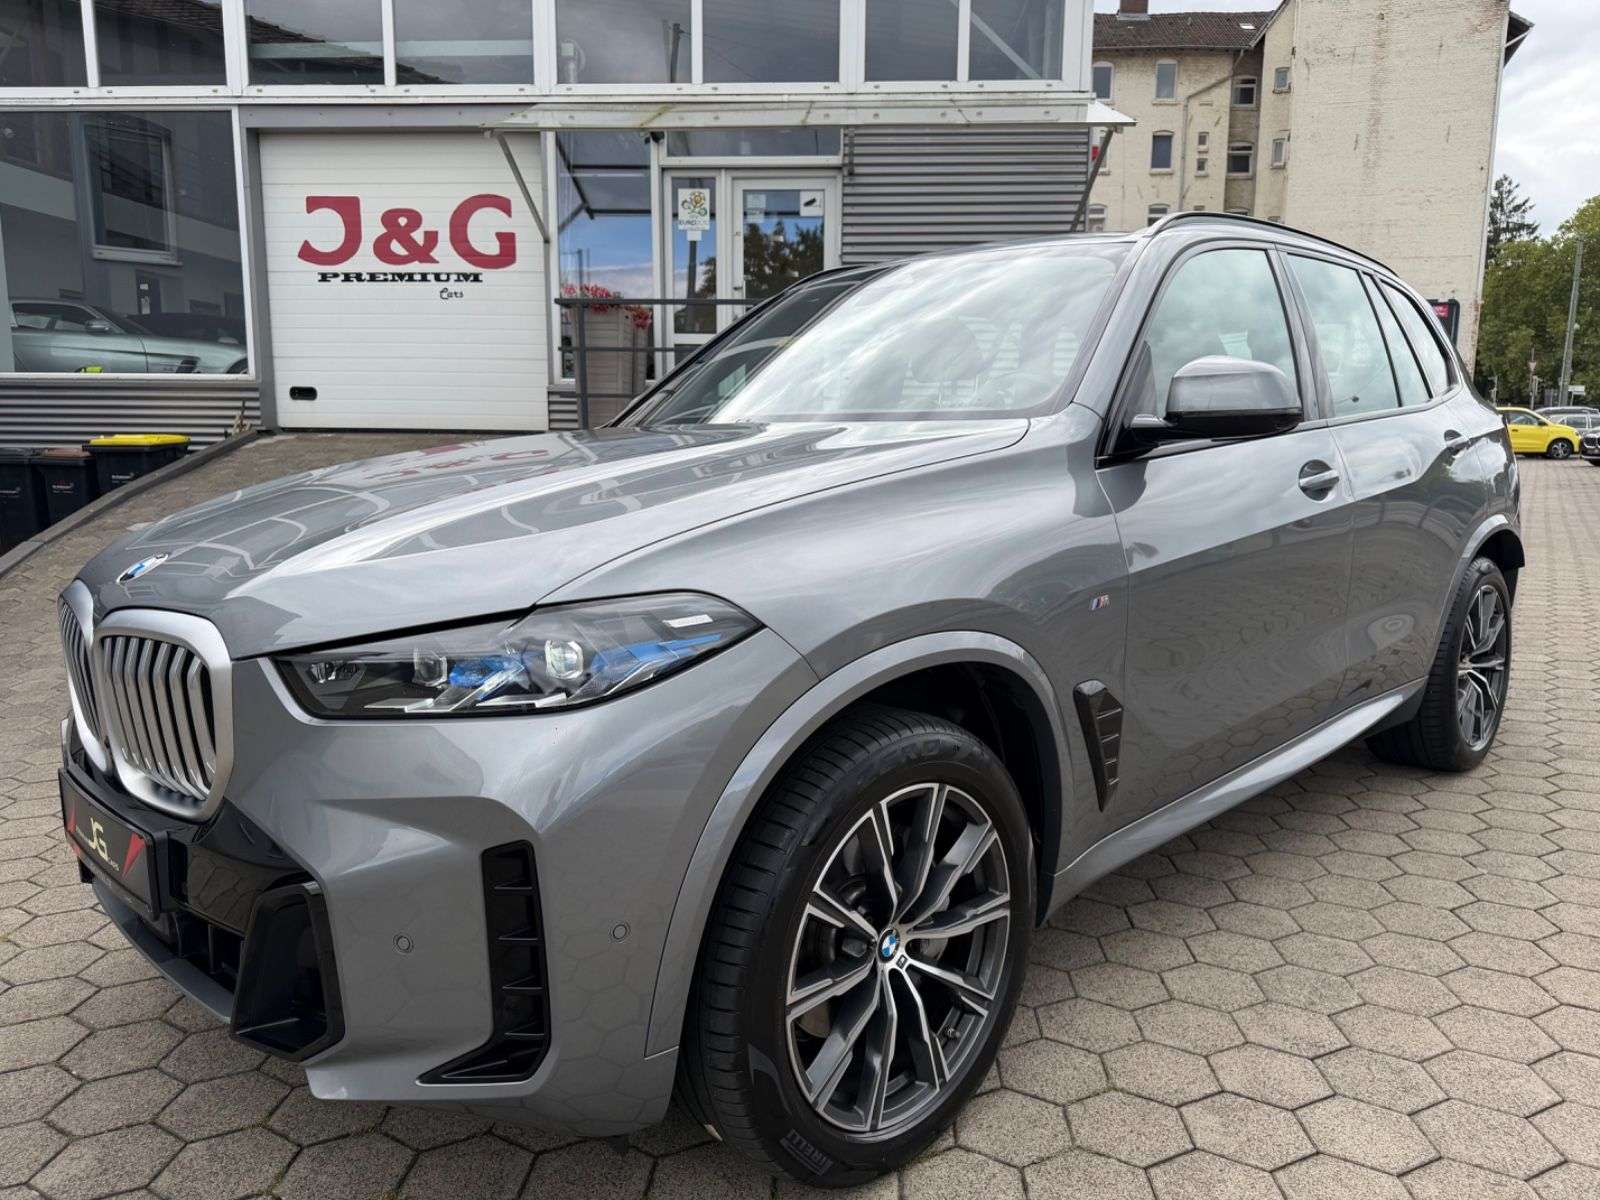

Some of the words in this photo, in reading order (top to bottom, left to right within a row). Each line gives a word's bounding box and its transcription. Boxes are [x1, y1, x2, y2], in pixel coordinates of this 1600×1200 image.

[298, 193, 517, 269] J&G
[318, 272, 483, 283] PREMIUM
[439, 287, 464, 300] Cars
